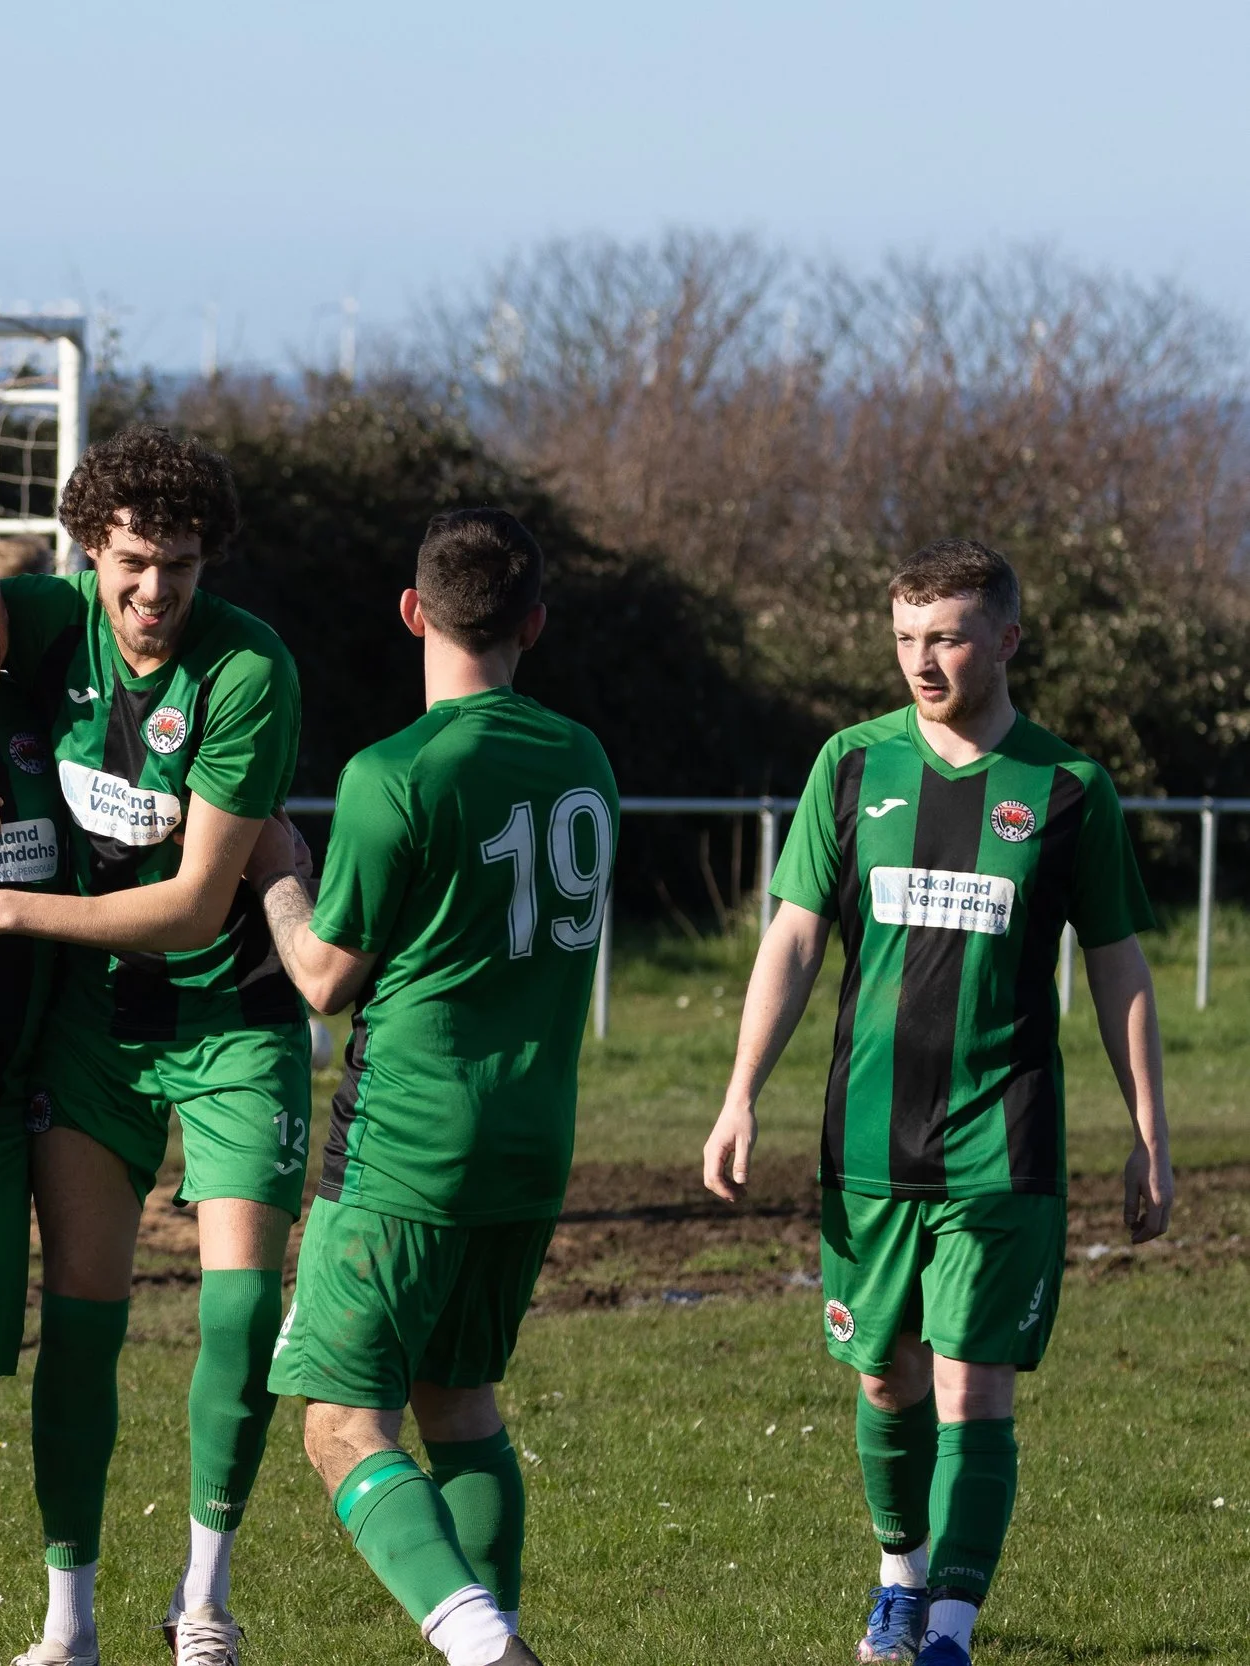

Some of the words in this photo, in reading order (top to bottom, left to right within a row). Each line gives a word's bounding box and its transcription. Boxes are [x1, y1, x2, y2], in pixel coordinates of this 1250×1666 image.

[91, 775, 156, 810] Lakend
[479, 786, 613, 960] 19
[907, 873, 992, 896] Lakeland
[908, 890, 1007, 916] Verandahs
[273, 1110, 306, 1156] 12
